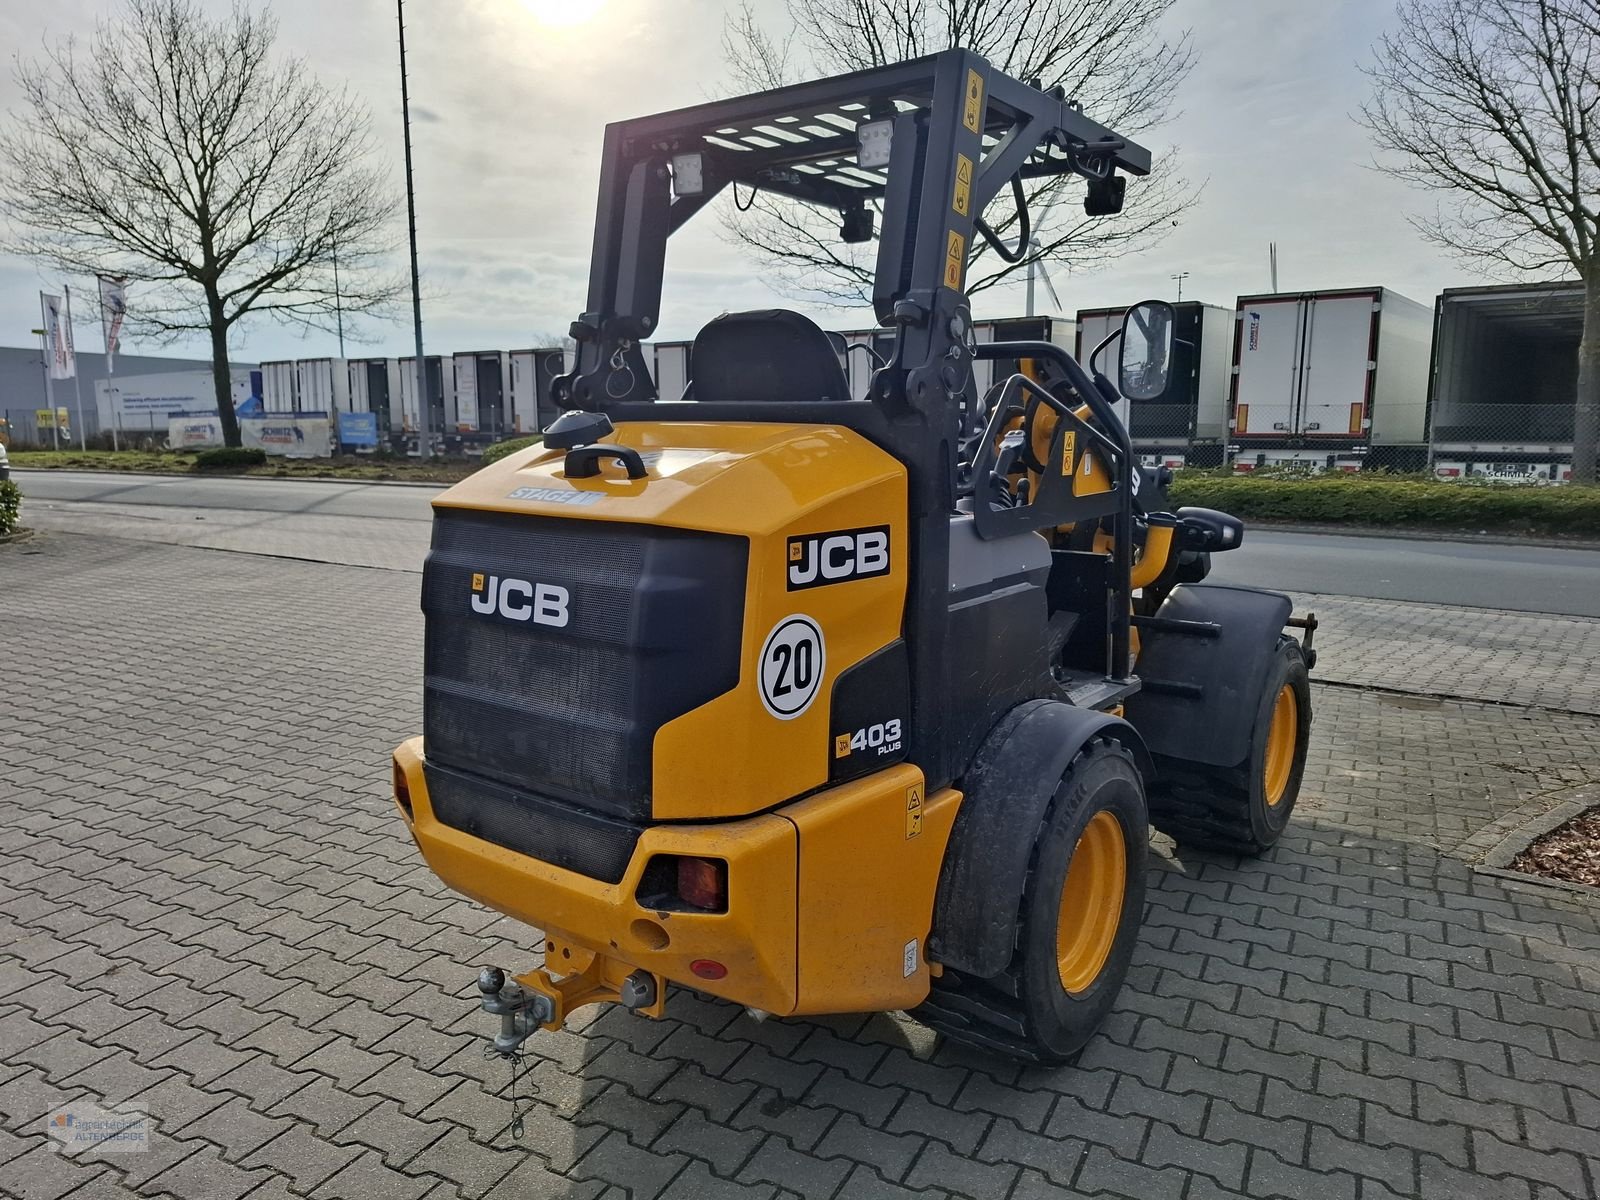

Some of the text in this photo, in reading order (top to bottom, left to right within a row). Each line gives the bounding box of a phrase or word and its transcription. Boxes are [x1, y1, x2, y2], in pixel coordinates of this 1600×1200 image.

[1487, 470, 1534, 479] SCHMITZ
[510, 487, 574, 504] STAGE
[789, 531, 888, 585] JCB
[471, 575, 570, 628] JCB
[773, 639, 812, 698] 20
[850, 718, 902, 751] 403
[877, 741, 902, 756] PLUS
